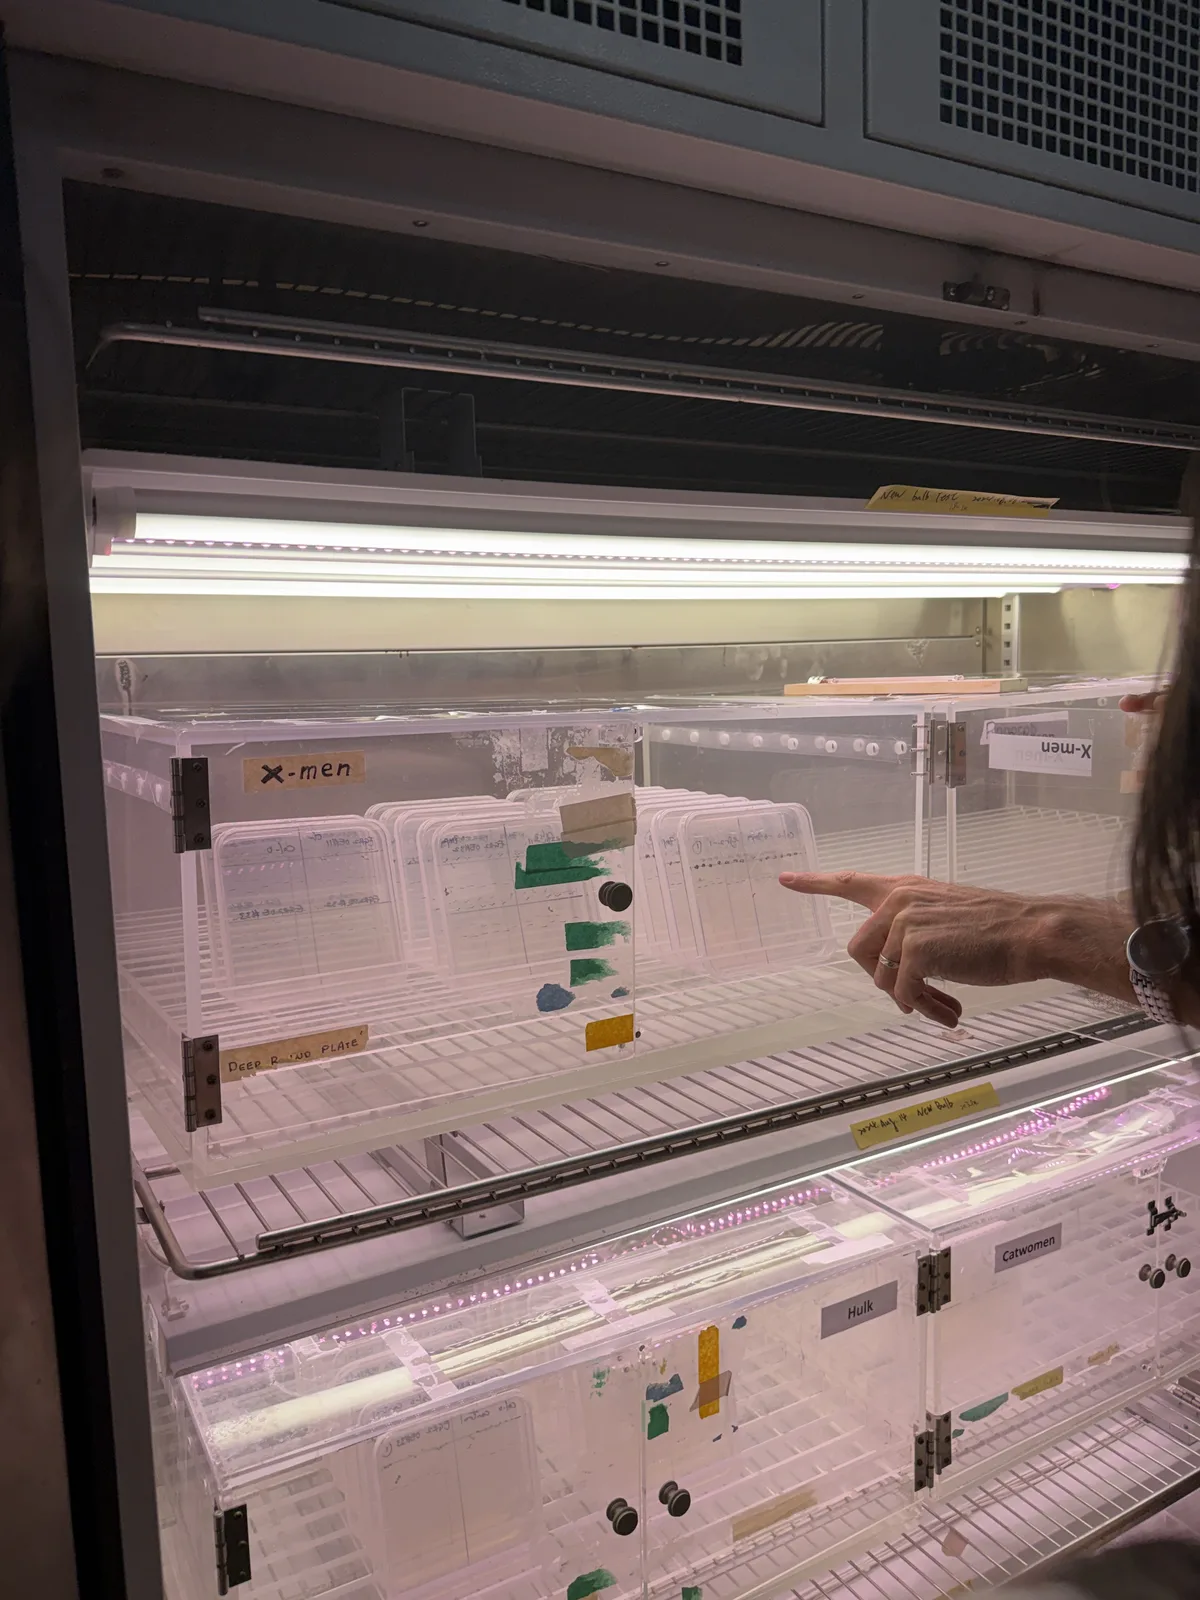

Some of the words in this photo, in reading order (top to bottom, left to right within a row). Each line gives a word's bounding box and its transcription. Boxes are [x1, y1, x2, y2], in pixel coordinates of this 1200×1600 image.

[1041, 740, 1092, 759] X-men
[228, 1060, 261, 1073] DEEP
[321, 1038, 359, 1054] PLATE
[917, 1105, 933, 1117] New
[934, 1097, 955, 1110] Bulb
[1002, 1234, 1056, 1263] Catwomen
[847, 1301, 874, 1320] Hulk
